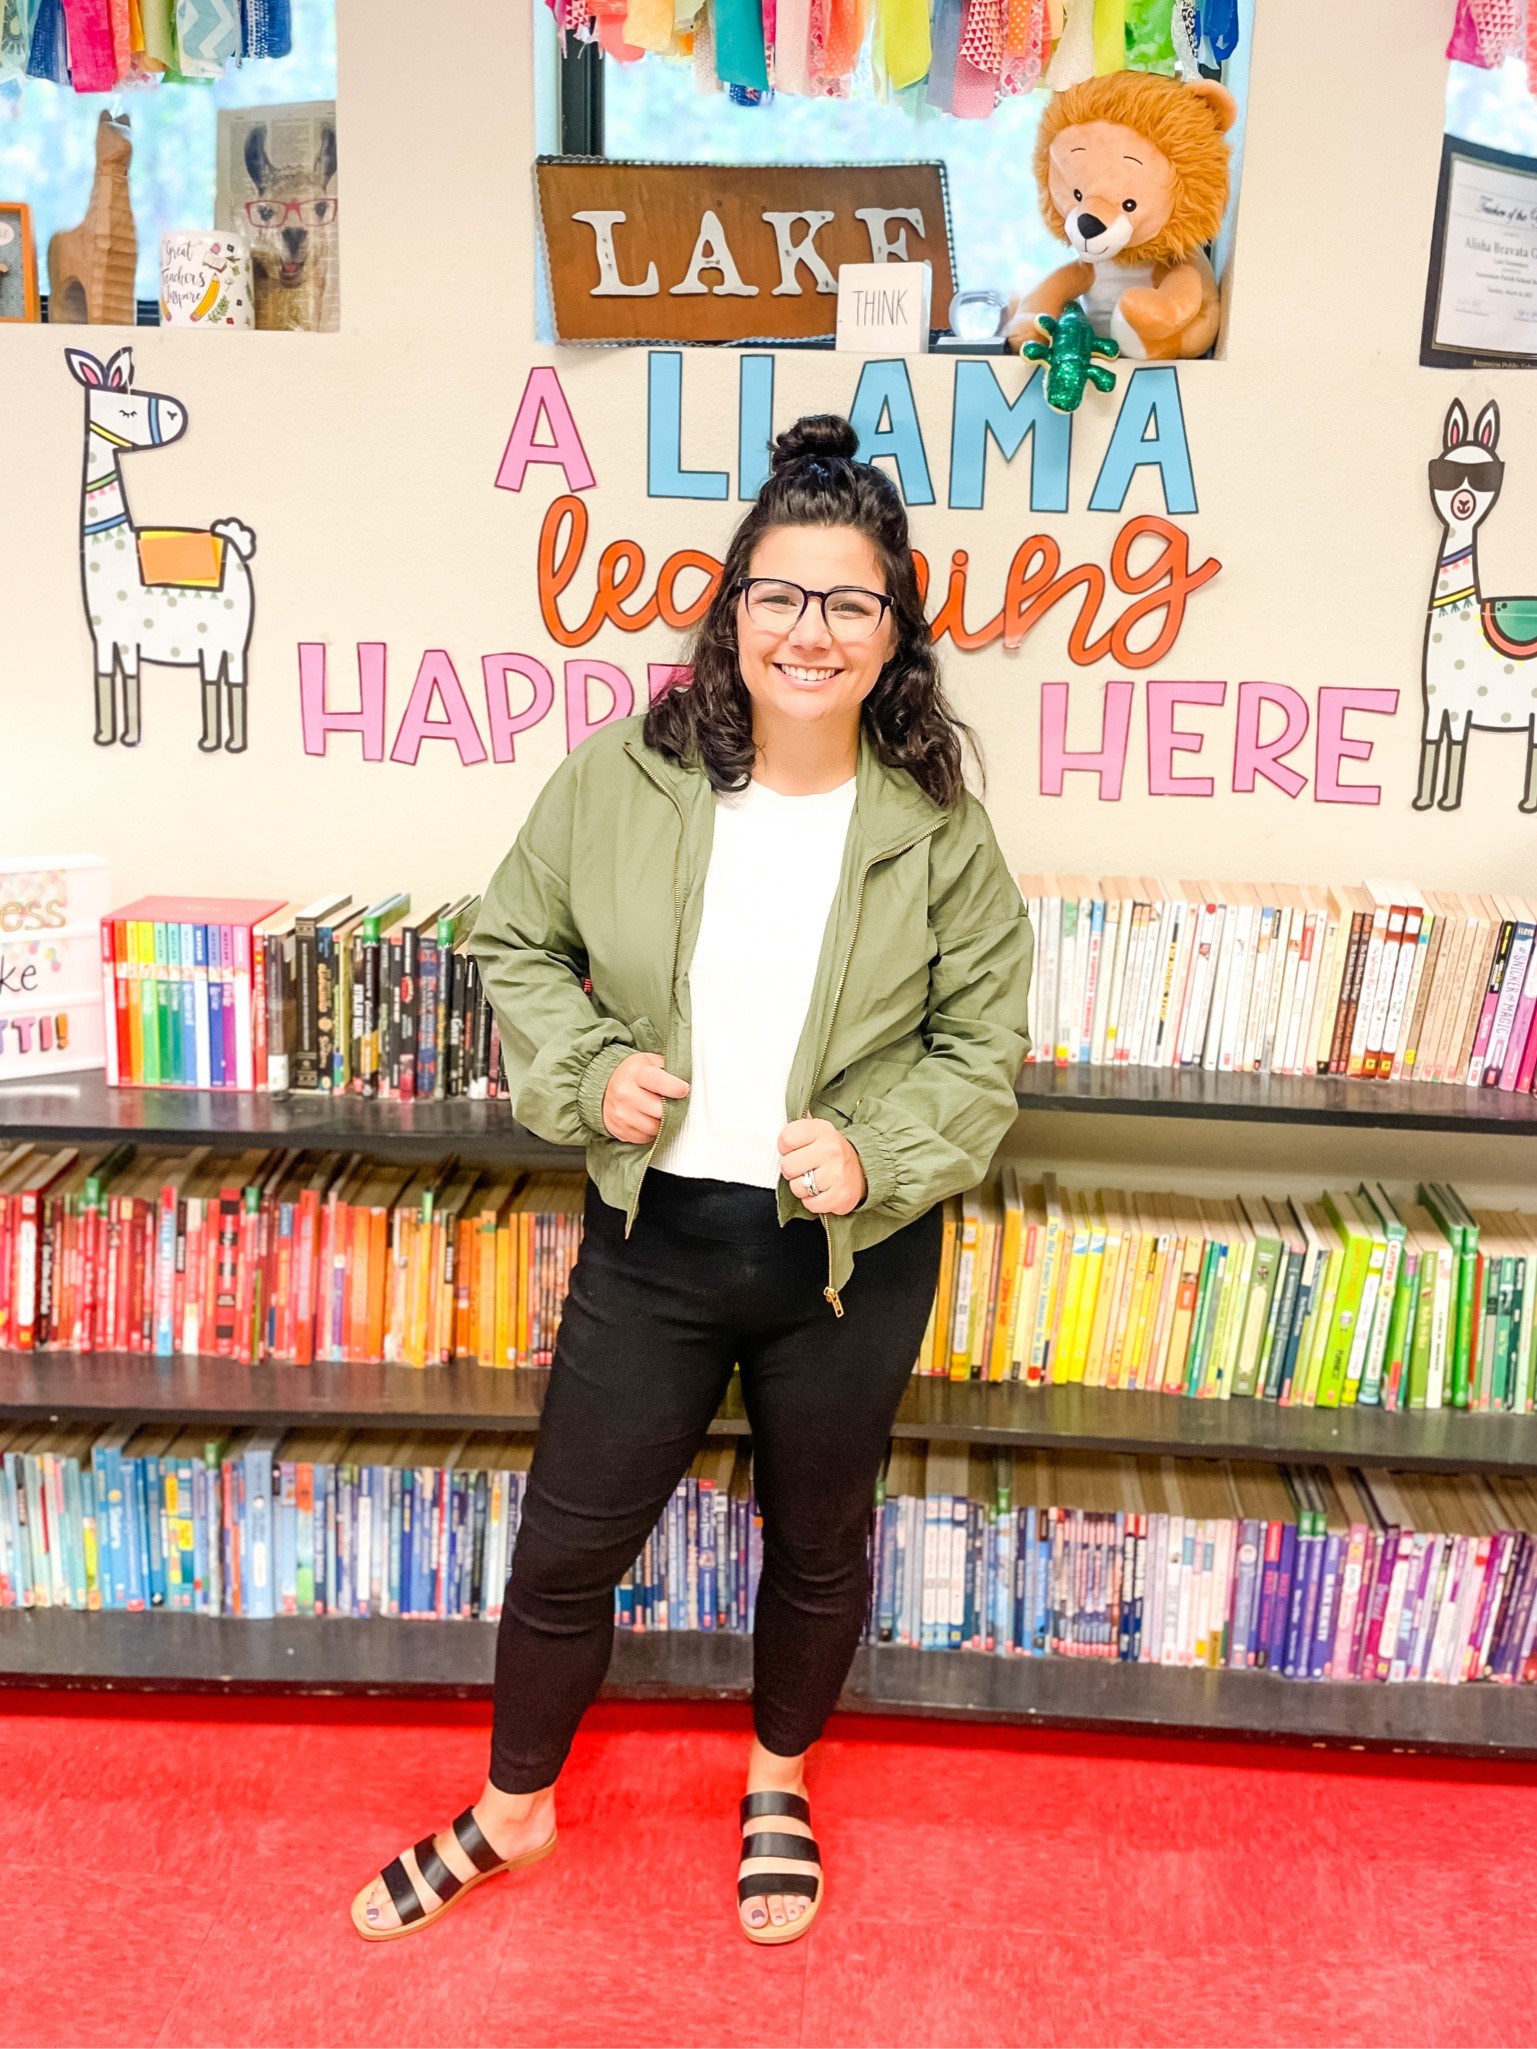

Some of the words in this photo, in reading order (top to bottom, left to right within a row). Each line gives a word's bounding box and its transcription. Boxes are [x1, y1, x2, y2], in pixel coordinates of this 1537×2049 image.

[166, 240, 201, 265] Great
[572, 208, 932, 296] LAKE
[1464, 237, 1491, 252] Alisha
[1494, 242, 1528, 257] Bravata
[162, 265, 206, 287] Teachers
[166, 286, 201, 309] Inspire
[852, 288, 908, 326] THINK
[495, 367, 596, 492] A
[537, 495, 1222, 669] leaing
[1041, 681, 1400, 805] HERE
[1506, 955, 1526, 993] SNICKER
[1496, 1003, 1515, 1034] MAGIC
[1048, 1223, 1059, 1236] The
[1046, 1239, 1056, 1253] Old
[1041, 1257, 1054, 1291] Farmer's
[1036, 1295, 1048, 1328] Almanac
[1034, 1331, 1044, 1343] for
[1032, 1347, 1042, 1364] Kids
